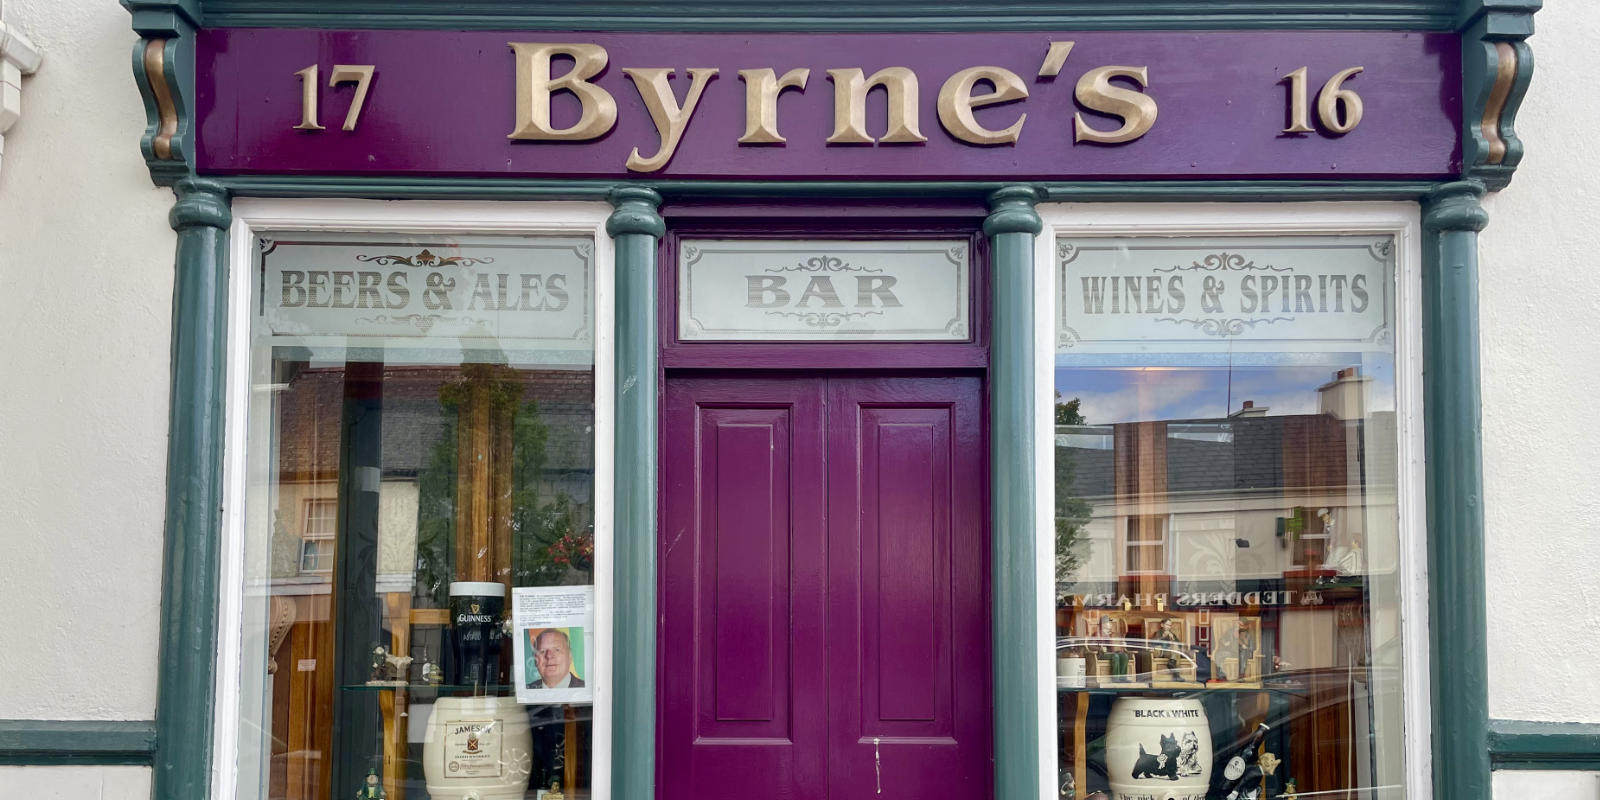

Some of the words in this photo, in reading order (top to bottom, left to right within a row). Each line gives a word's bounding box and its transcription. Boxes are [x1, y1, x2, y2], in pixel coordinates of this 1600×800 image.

[291, 63, 376, 132] 17
[506, 40, 1158, 173] Byrne's
[1280, 65, 1364, 134] 16
[279, 270, 410, 310] BEERS
[422, 271, 456, 311] &
[467, 272, 569, 312] ALES
[744, 274, 904, 309] BAR
[1080, 274, 1186, 314] WINES
[1200, 275, 1225, 314] &
[1240, 274, 1369, 314] SPIRITS
[459, 613, 492, 623] GUINNESS
[1135, 709, 1165, 718] BLACK
[1172, 709, 1199, 718] WHITE
